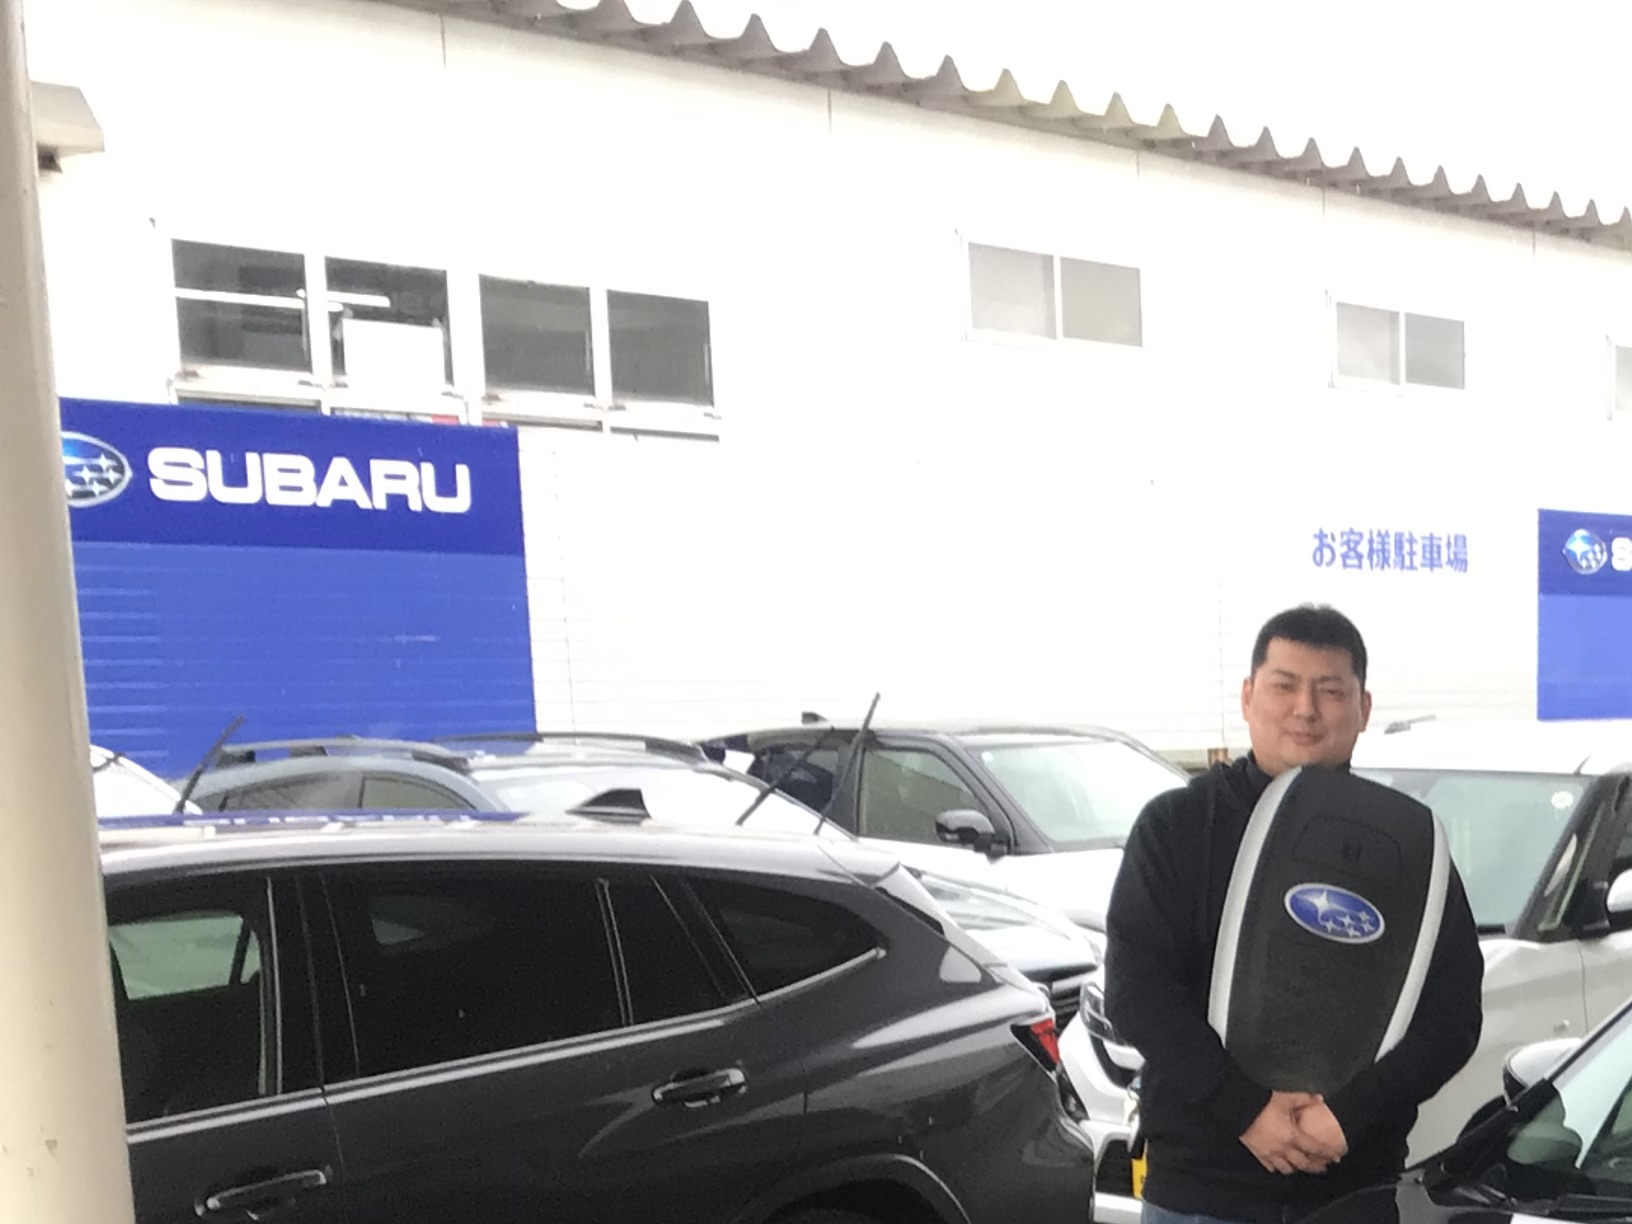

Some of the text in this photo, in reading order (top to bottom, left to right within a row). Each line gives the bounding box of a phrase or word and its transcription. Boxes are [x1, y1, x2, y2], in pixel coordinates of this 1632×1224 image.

[147, 446, 472, 514] SUBARU
[1312, 527, 1470, 573] お客様駐車場
